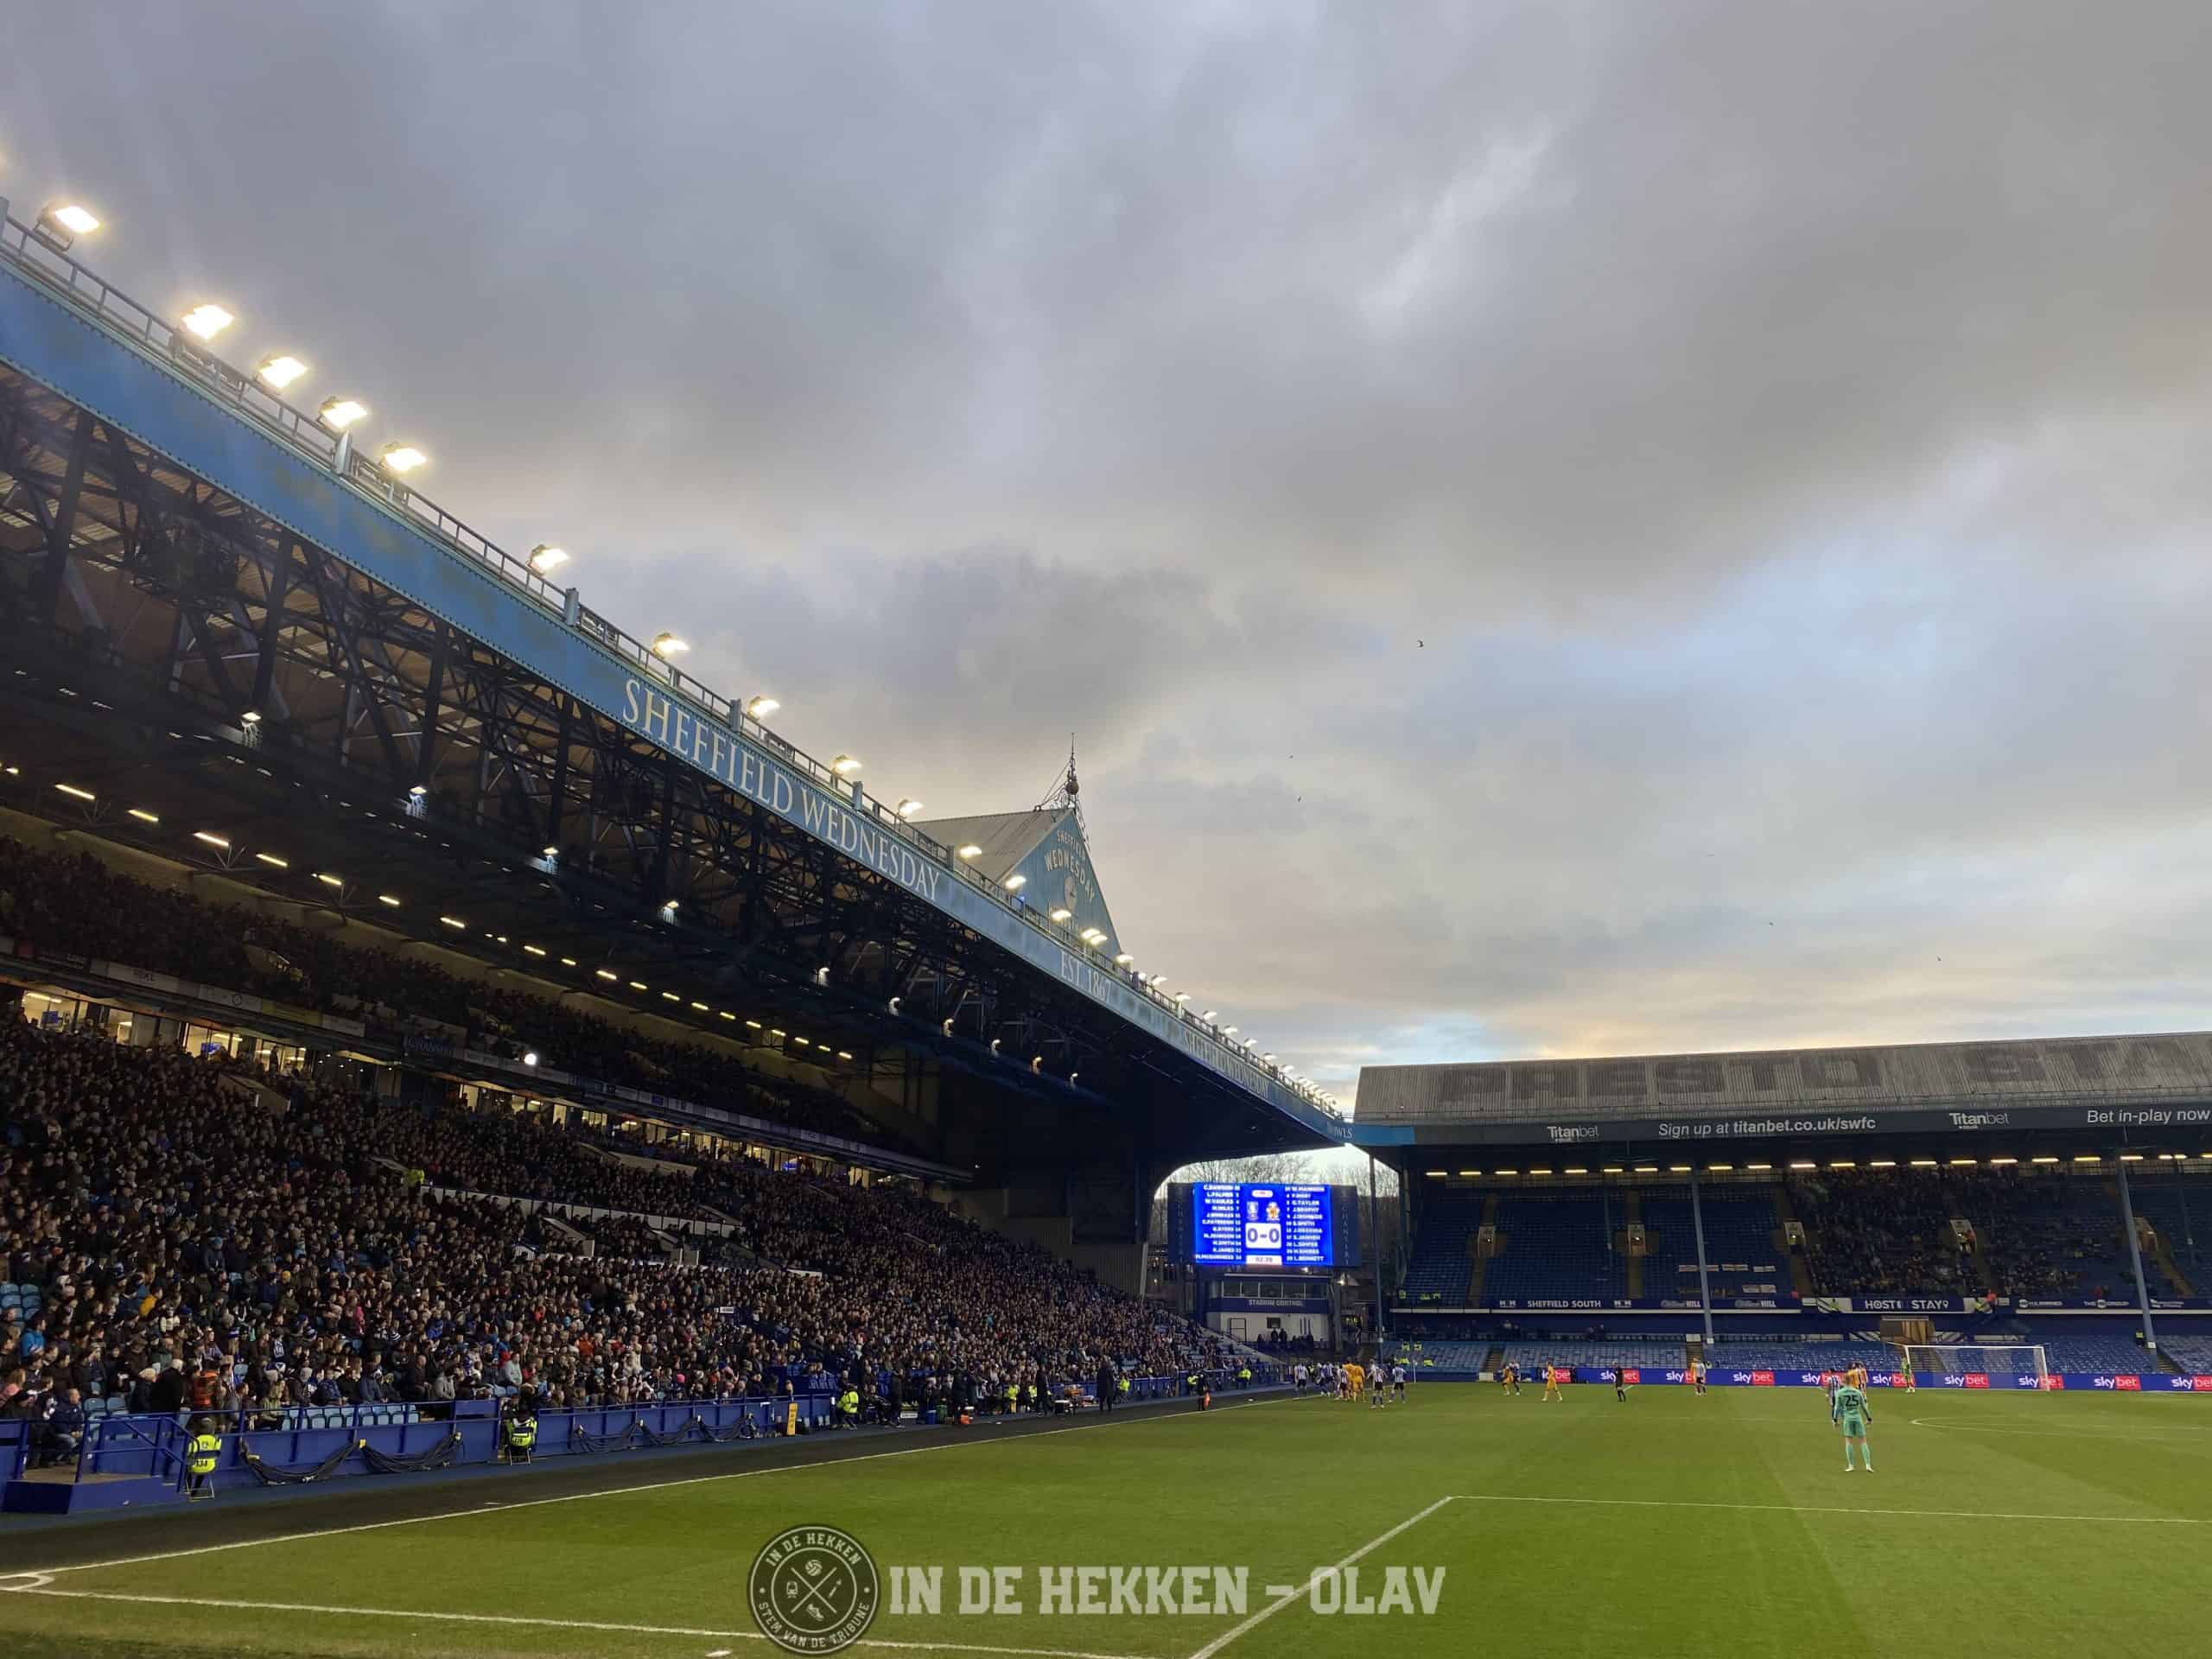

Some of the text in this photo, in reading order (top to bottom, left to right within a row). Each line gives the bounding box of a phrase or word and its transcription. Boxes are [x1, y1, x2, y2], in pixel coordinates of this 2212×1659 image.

[623, 678, 940, 901] SHEFFIELD WEDNESDAY
[1044, 849, 1096, 904] WEDNESDAY
[1088, 967, 1113, 1003] 1867
[1949, 1112, 2010, 1126] Titanbet
[2087, 1109, 2210, 1124] Bet in-play now
[1547, 1126, 1599, 1139] Titanbet
[1658, 1116, 1877, 1139] Sign up at titanbet.co.uk/swfc
[1865, 1300, 1943, 1310] HOST STAY
[1666, 1371, 1684, 1383] sky
[1733, 1372, 1771, 1384] sky bet
[1802, 1373, 1821, 1385] sky
[1872, 1373, 1891, 1386] sky
[1944, 1374, 1986, 1387] sky bet
[2018, 1376, 2038, 1389] sky
[2094, 1376, 2137, 1389] sky bet
[2171, 1376, 2193, 1389] sky
[1844, 1395, 1859, 1407] 25
